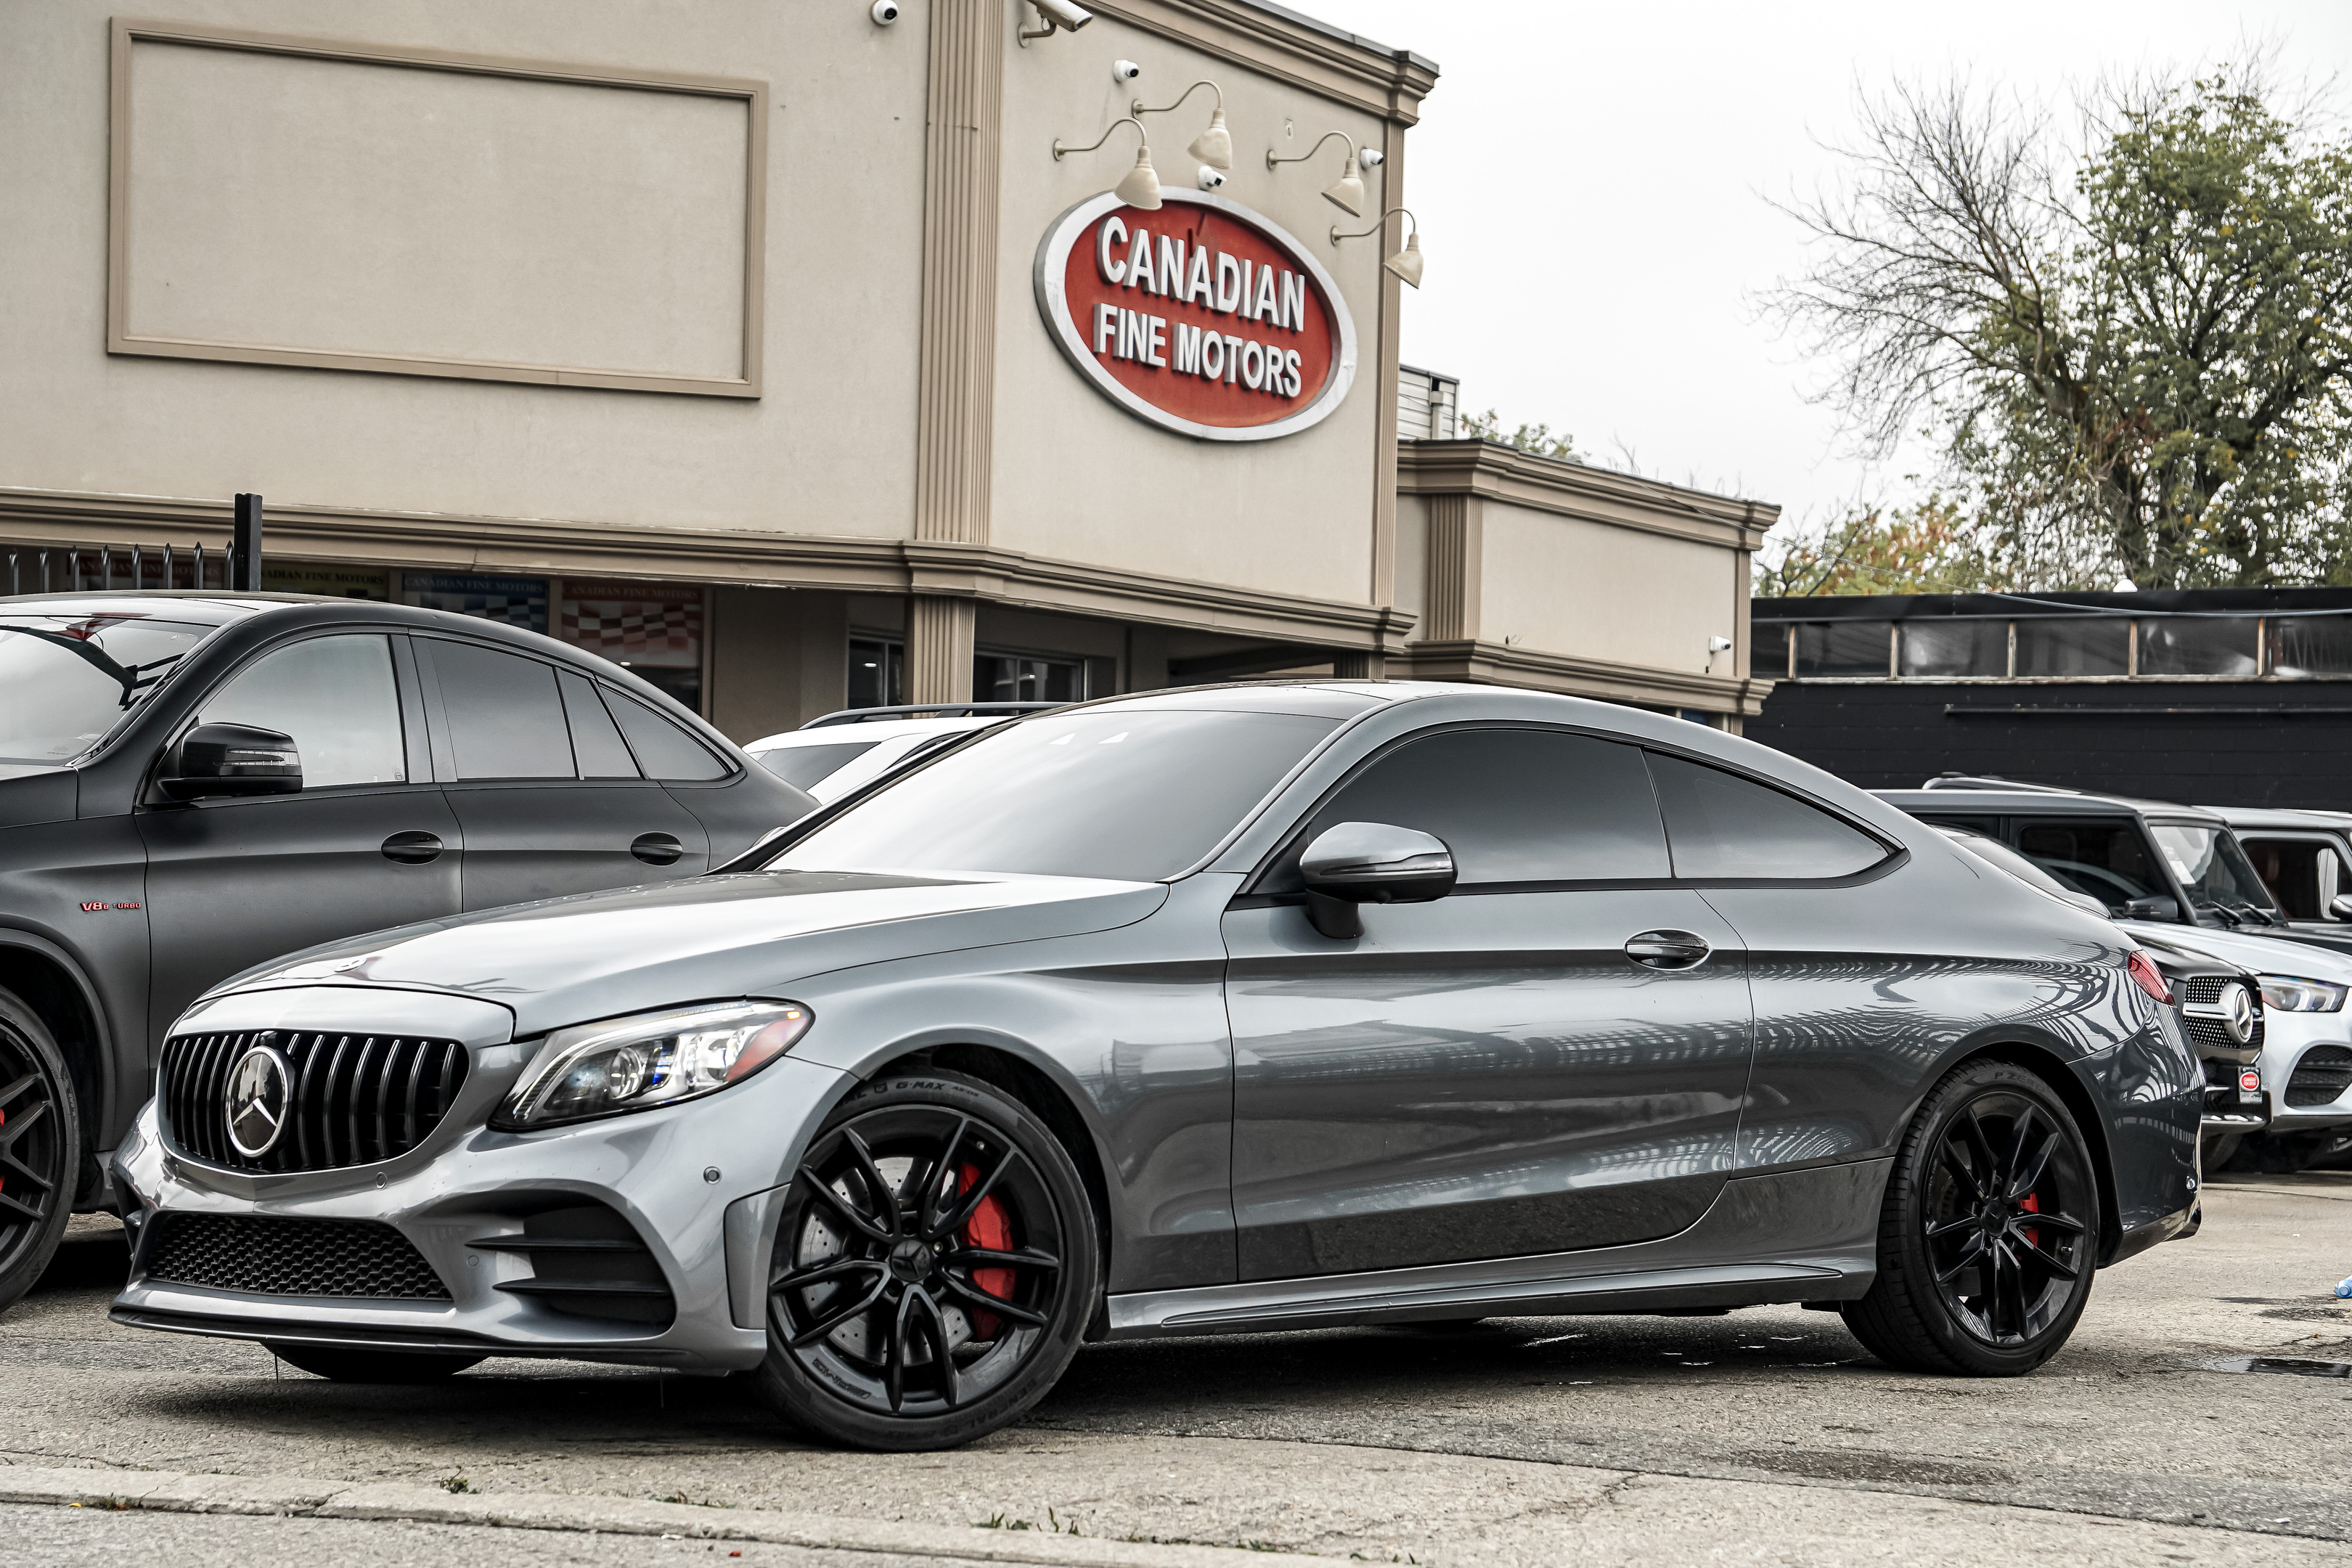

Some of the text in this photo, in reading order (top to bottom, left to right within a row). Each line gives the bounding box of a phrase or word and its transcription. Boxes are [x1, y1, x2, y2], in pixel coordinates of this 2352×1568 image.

[1098, 216, 1304, 332] CANADIAN
[1094, 303, 1302, 398] FINE MOTORS
[305, 571, 332, 581] FINE
[335, 572, 384, 584] MOTORS
[404, 576, 544, 593] CANADIAN FINE MOTORS
[563, 586, 698, 600] CANADIAN FINE MOTORS
[2006, 1072, 2046, 1093] ZERO
